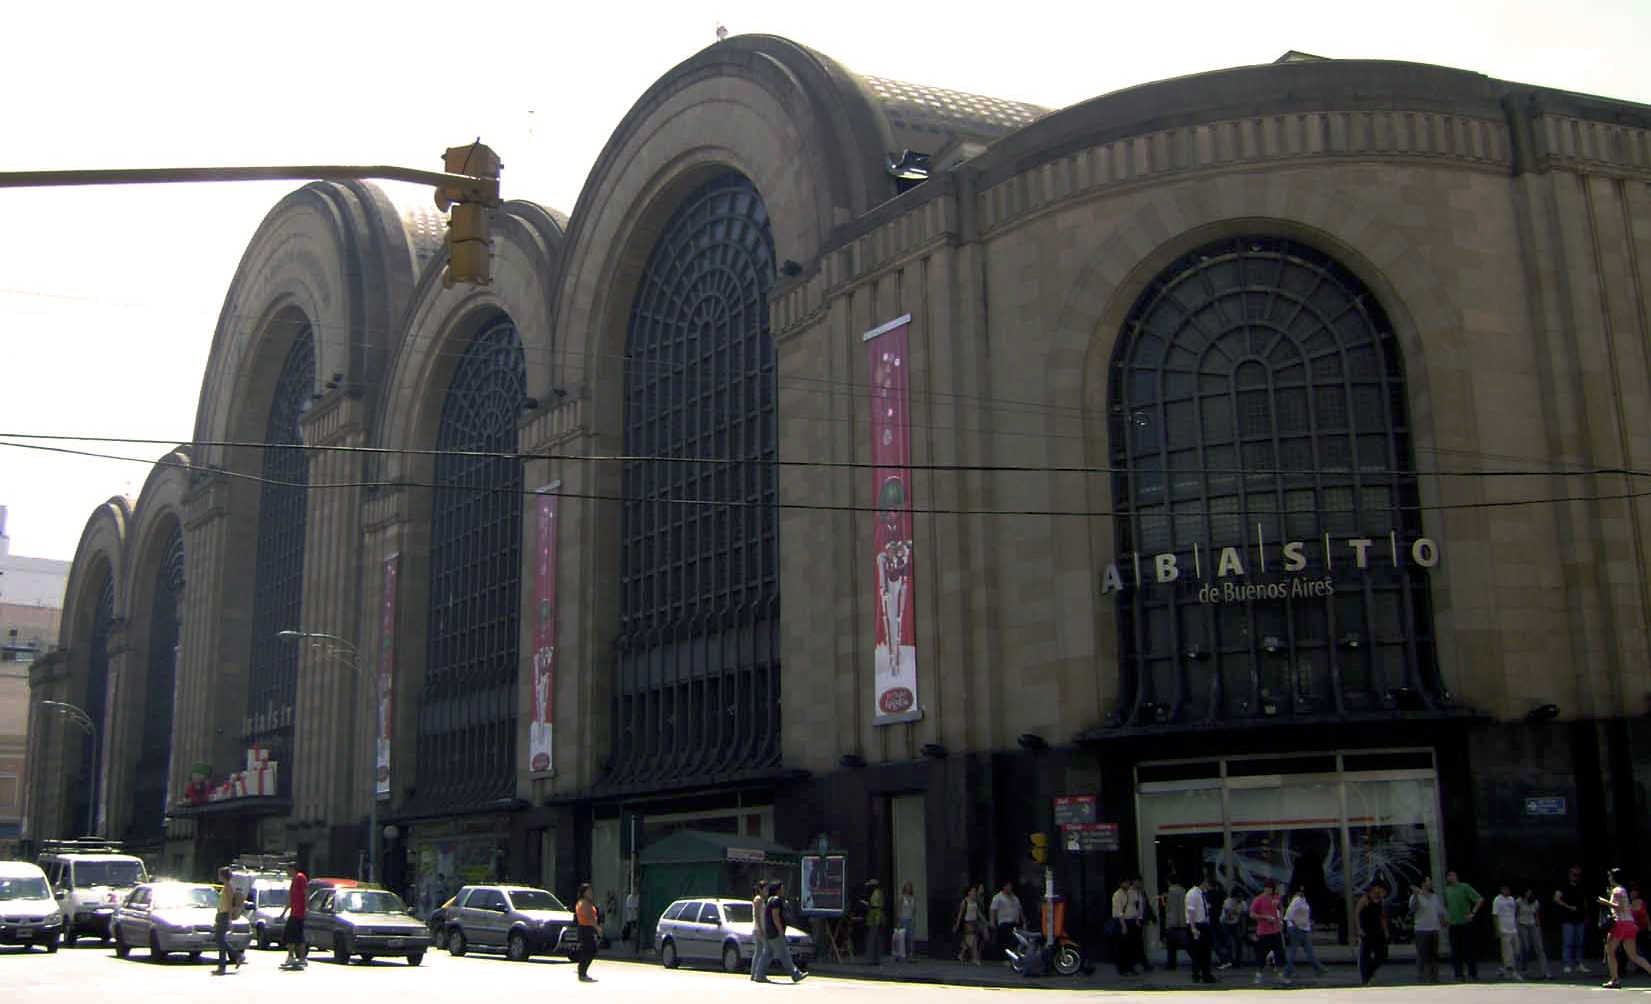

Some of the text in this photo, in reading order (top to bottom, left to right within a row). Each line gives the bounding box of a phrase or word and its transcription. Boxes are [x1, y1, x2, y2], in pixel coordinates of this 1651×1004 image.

[1101, 536, 1440, 595] ABASTO
[1199, 576, 1334, 604] de Buenos Aires
